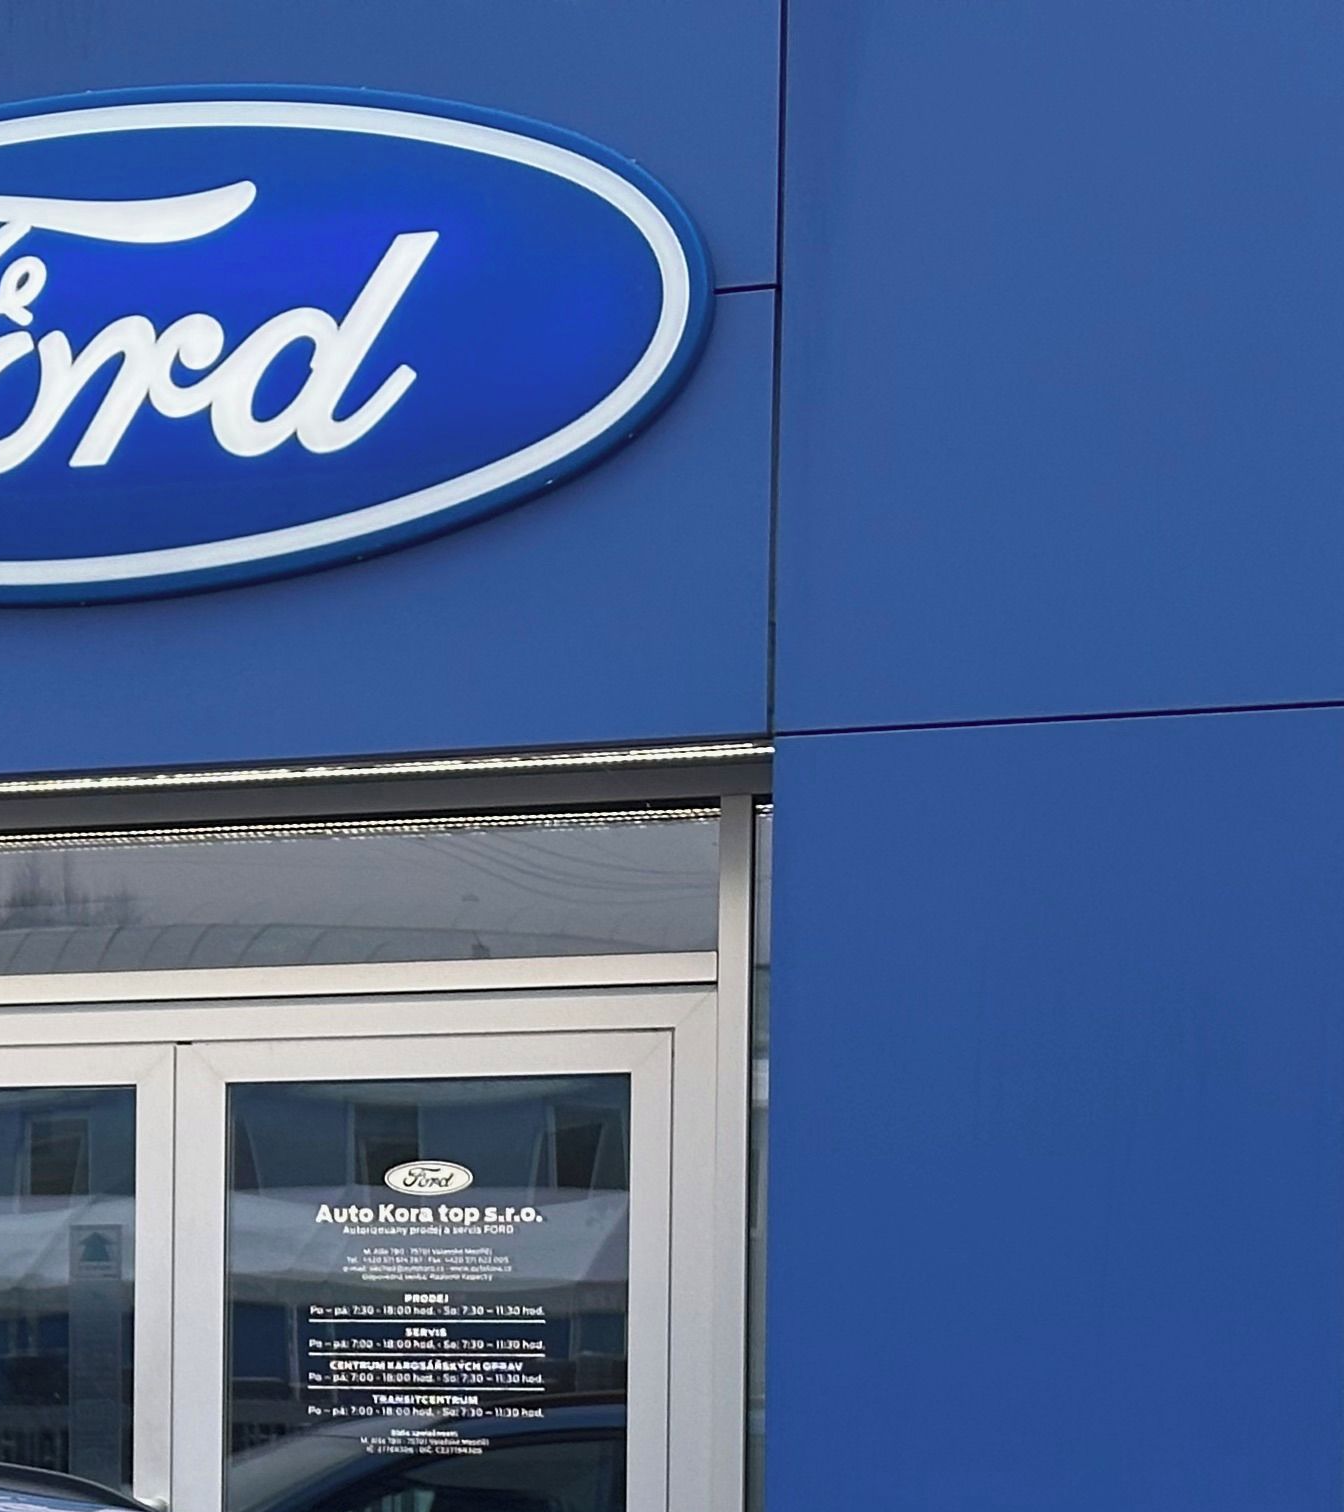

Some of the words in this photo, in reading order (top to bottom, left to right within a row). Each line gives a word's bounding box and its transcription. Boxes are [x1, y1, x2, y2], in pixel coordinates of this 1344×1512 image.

[402, 1166, 454, 1189] Ford
[315, 1204, 374, 1223] Auto
[379, 1204, 434, 1223] Kora
[438, 1204, 480, 1227] top
[484, 1207, 543, 1223] s.r.o.
[444, 1227, 451, 1235] a
[484, 1225, 514, 1235] FORD
[404, 1293, 449, 1304] PRODEJ
[404, 1327, 448, 1338] SERVIS
[329, 1360, 386, 1371] CENTRUM
[372, 1394, 479, 1405] TRANSITCENTRUM
